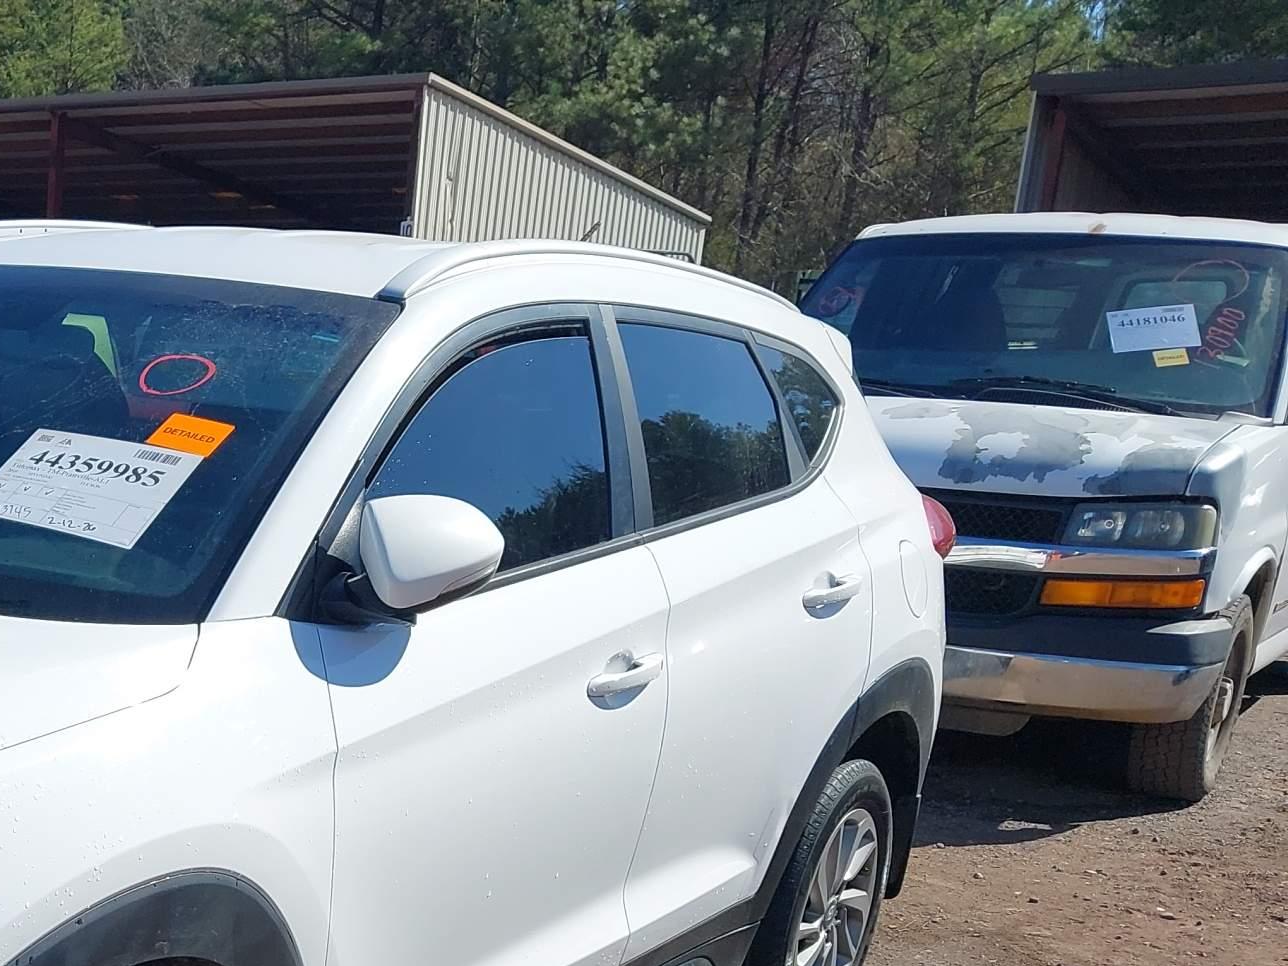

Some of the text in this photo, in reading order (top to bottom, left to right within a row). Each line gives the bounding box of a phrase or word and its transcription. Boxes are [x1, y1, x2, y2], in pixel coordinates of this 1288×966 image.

[1117, 313, 1186, 328] 44181046
[163, 426, 215, 444] DETAILED
[28, 448, 167, 488] 44359985
